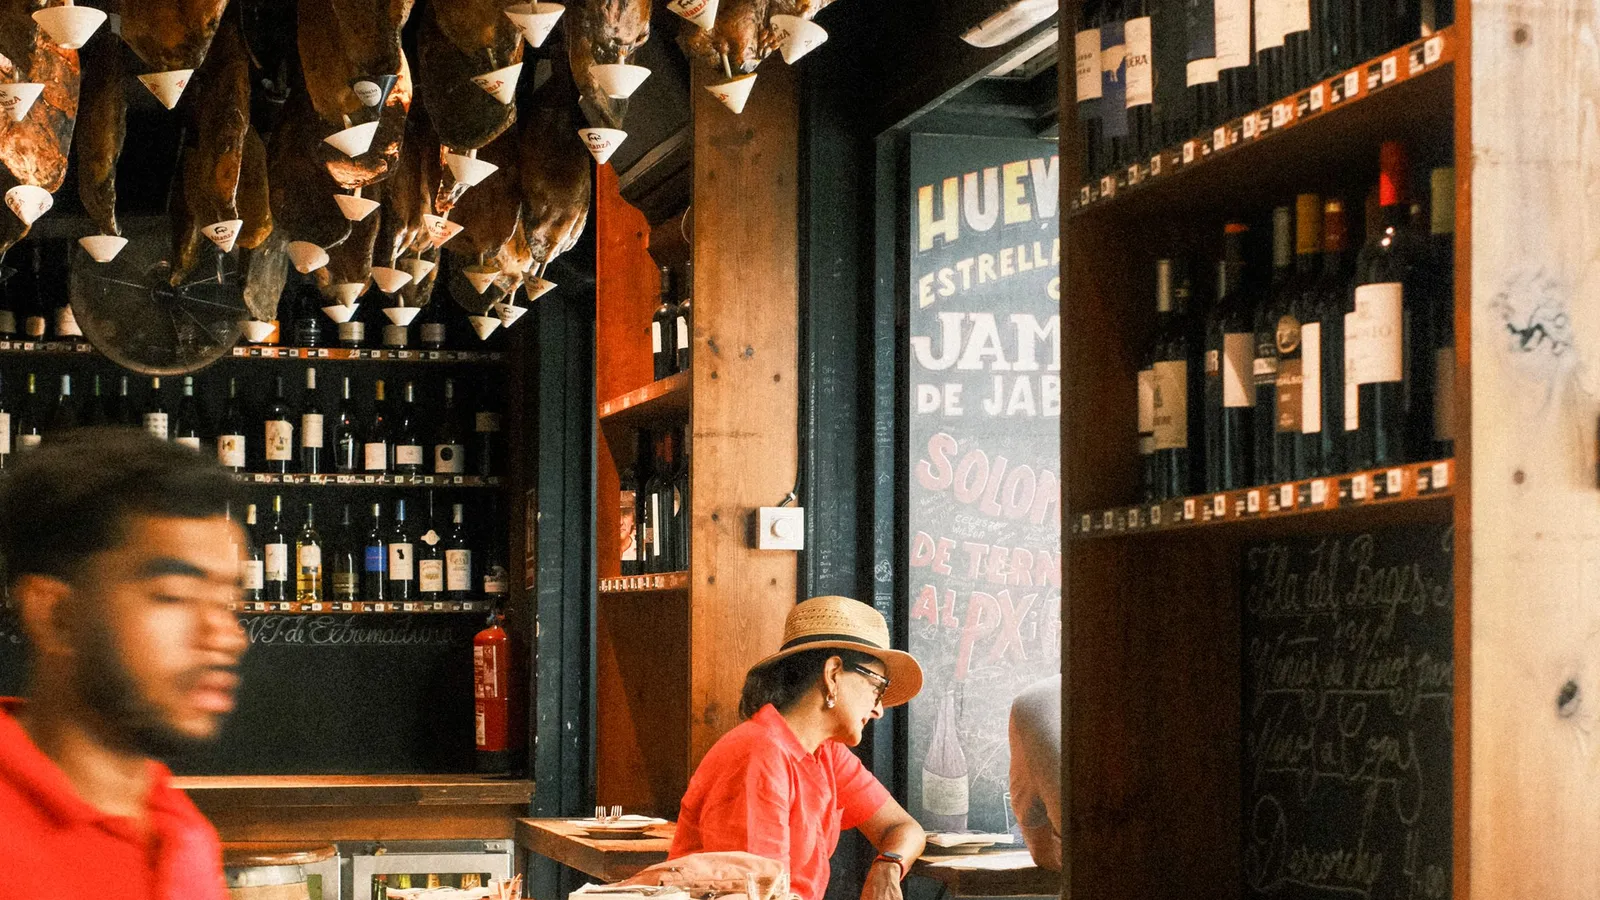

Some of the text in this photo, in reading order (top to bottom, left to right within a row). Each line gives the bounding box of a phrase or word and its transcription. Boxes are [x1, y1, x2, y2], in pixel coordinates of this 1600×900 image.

[911, 311, 1061, 371] JAM
[917, 374, 1061, 417] DE JAB
[910, 530, 1061, 586] DE TERN
[911, 583, 959, 629] AL
